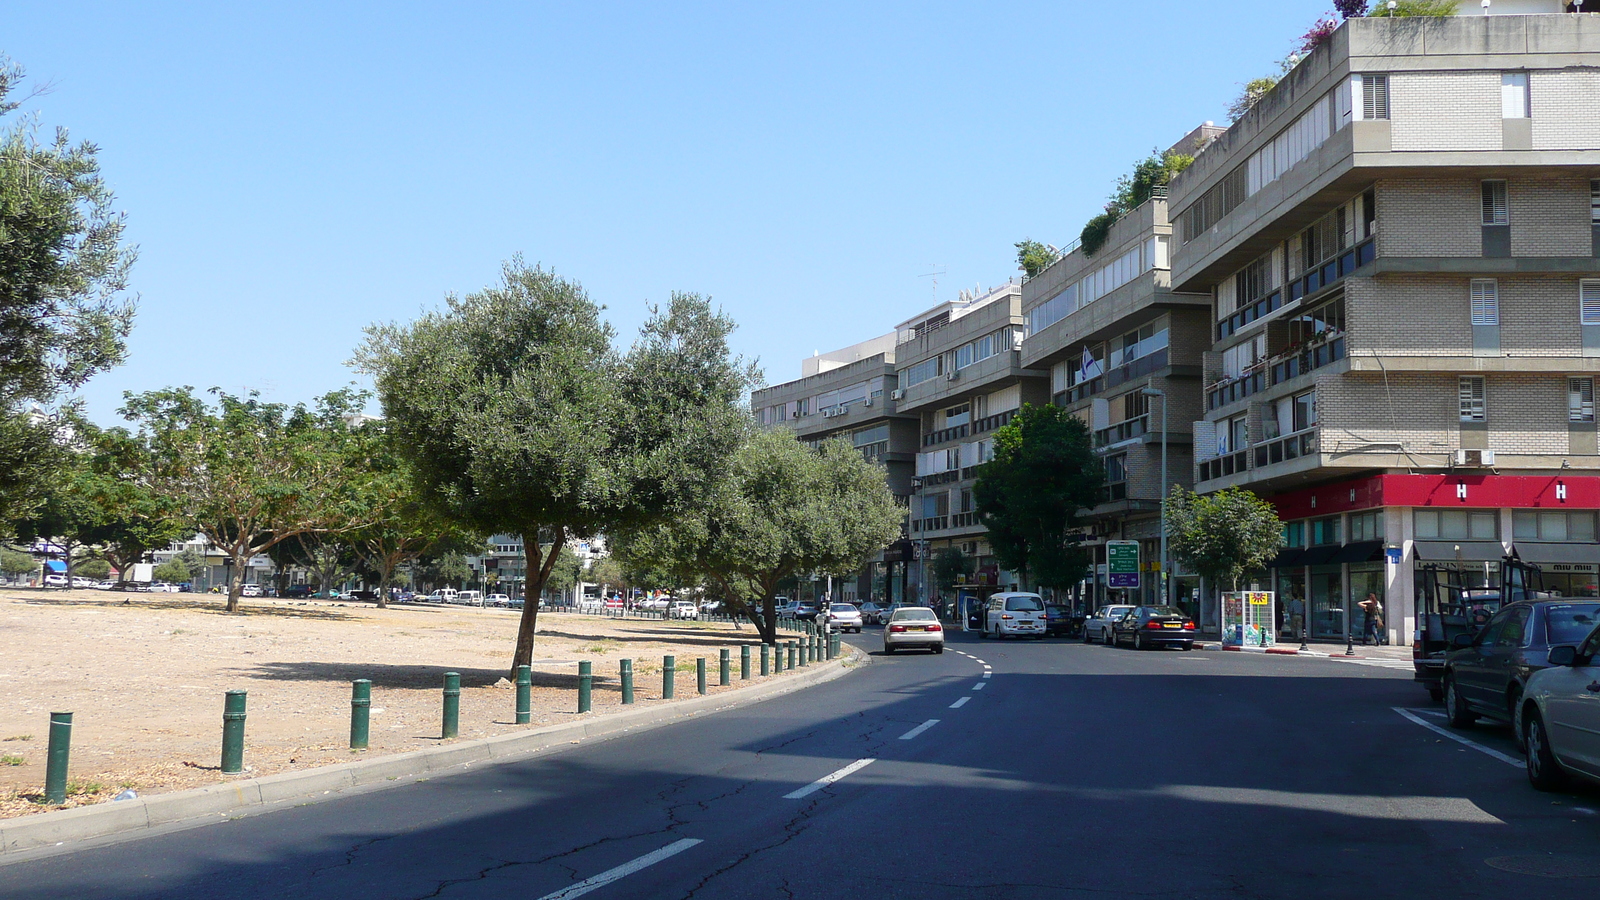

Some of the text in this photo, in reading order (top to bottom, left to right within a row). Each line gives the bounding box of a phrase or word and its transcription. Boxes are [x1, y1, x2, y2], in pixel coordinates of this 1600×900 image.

[1350, 488, 1355, 502] H
[1456, 484, 1467, 498] H
[1556, 485, 1566, 499] H
[1311, 496, 1316, 509] H
